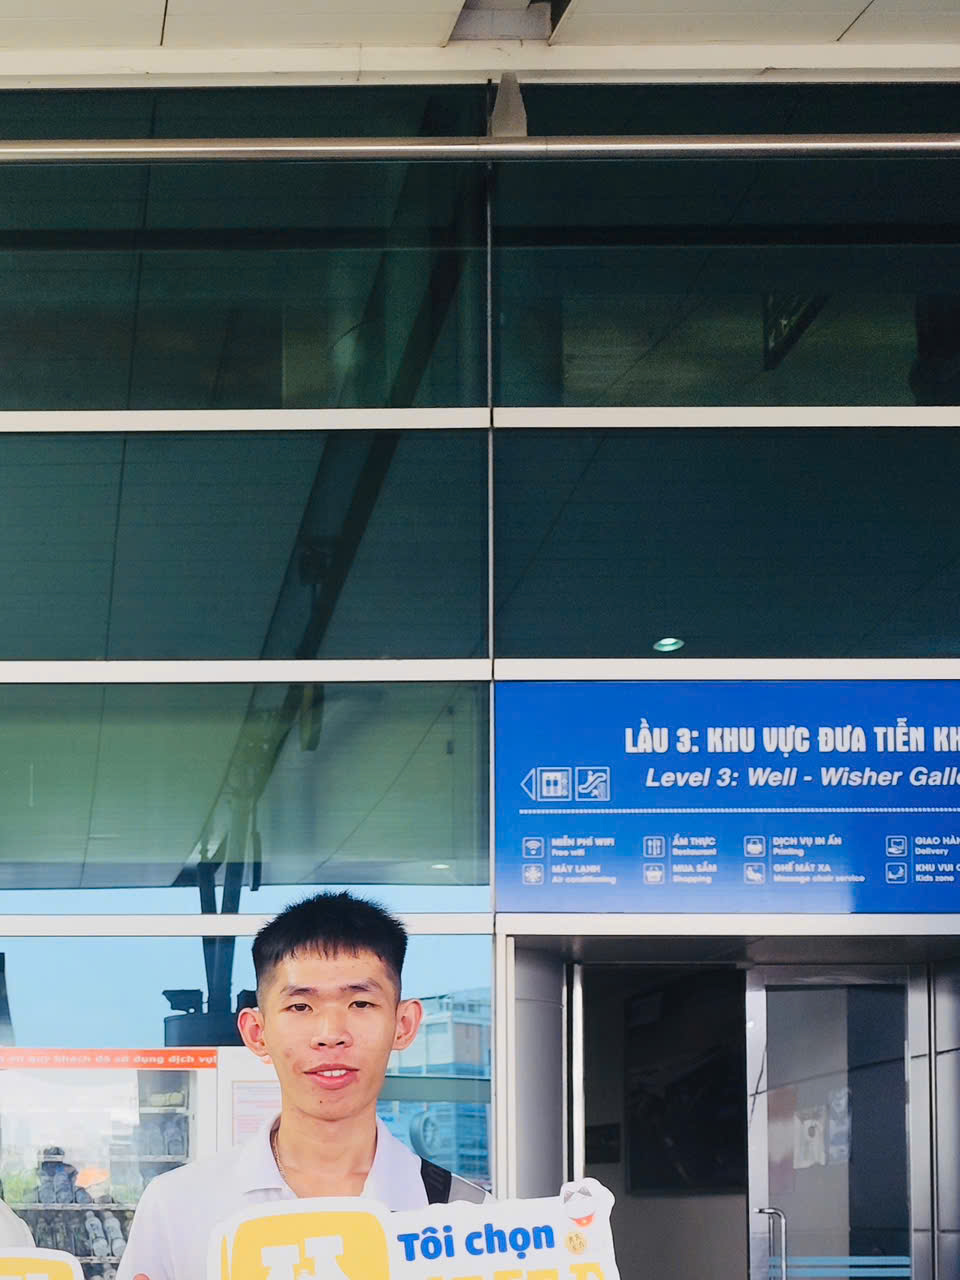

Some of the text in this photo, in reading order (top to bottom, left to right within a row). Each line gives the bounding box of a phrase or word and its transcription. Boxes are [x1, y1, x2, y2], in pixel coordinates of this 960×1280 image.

[625, 718, 668, 752] LẦU
[676, 727, 699, 752] 3:
[708, 727, 755, 752] KHU
[763, 725, 810, 757] VỰC
[818, 725, 866, 752] ĐƯA
[874, 718, 924, 752] TIỄN
[646, 768, 711, 787] Level
[717, 768, 738, 787] 3:
[749, 768, 797, 787] Well
[821, 767, 902, 786] Wisher
[799, 837, 813, 847] VỤ
[915, 848, 948, 856] Delivery
[817, 864, 831, 872] XA
[397, 1225, 454, 1261] Tôi
[466, 1224, 555, 1259] chọn
